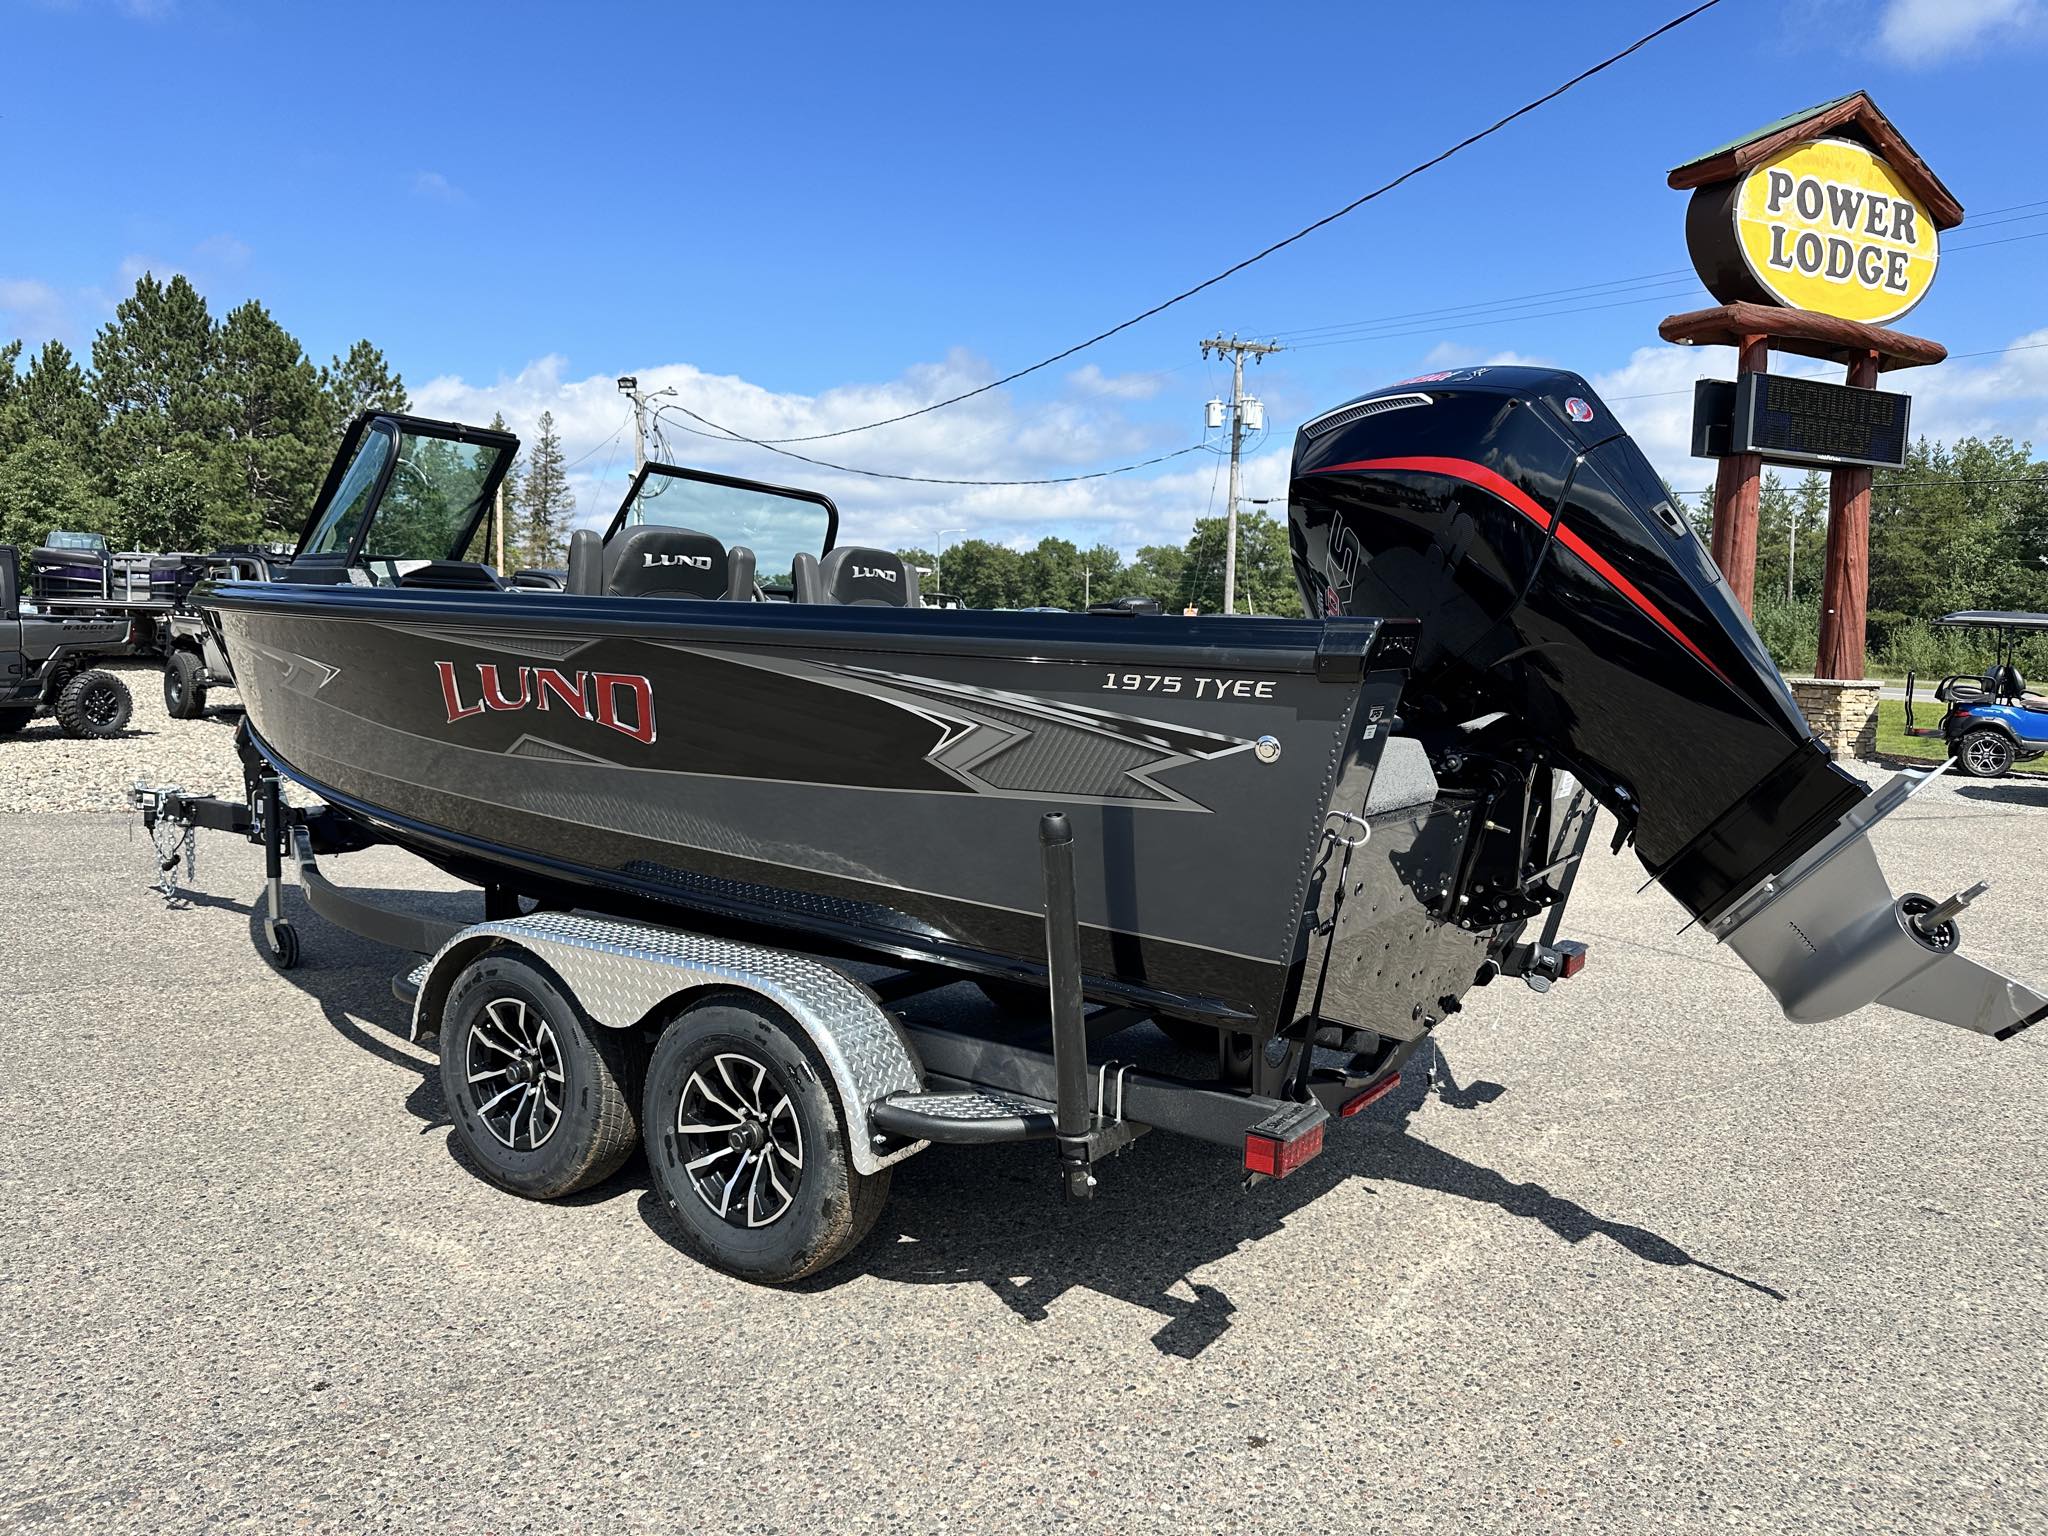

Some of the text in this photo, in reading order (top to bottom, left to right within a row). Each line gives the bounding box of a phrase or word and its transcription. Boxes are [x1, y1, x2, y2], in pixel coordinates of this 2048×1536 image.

[1768, 171, 1916, 245] POWER
[1769, 225, 1909, 292] LODGE
[1766, 379, 1895, 427] DISCOUNTED
[1789, 415, 1872, 455] PRICES!
[642, 553, 712, 570] LUND
[852, 565, 897, 583] LUND
[434, 661, 657, 745] LUND
[1102, 673, 1278, 700] 1975 TYEE
